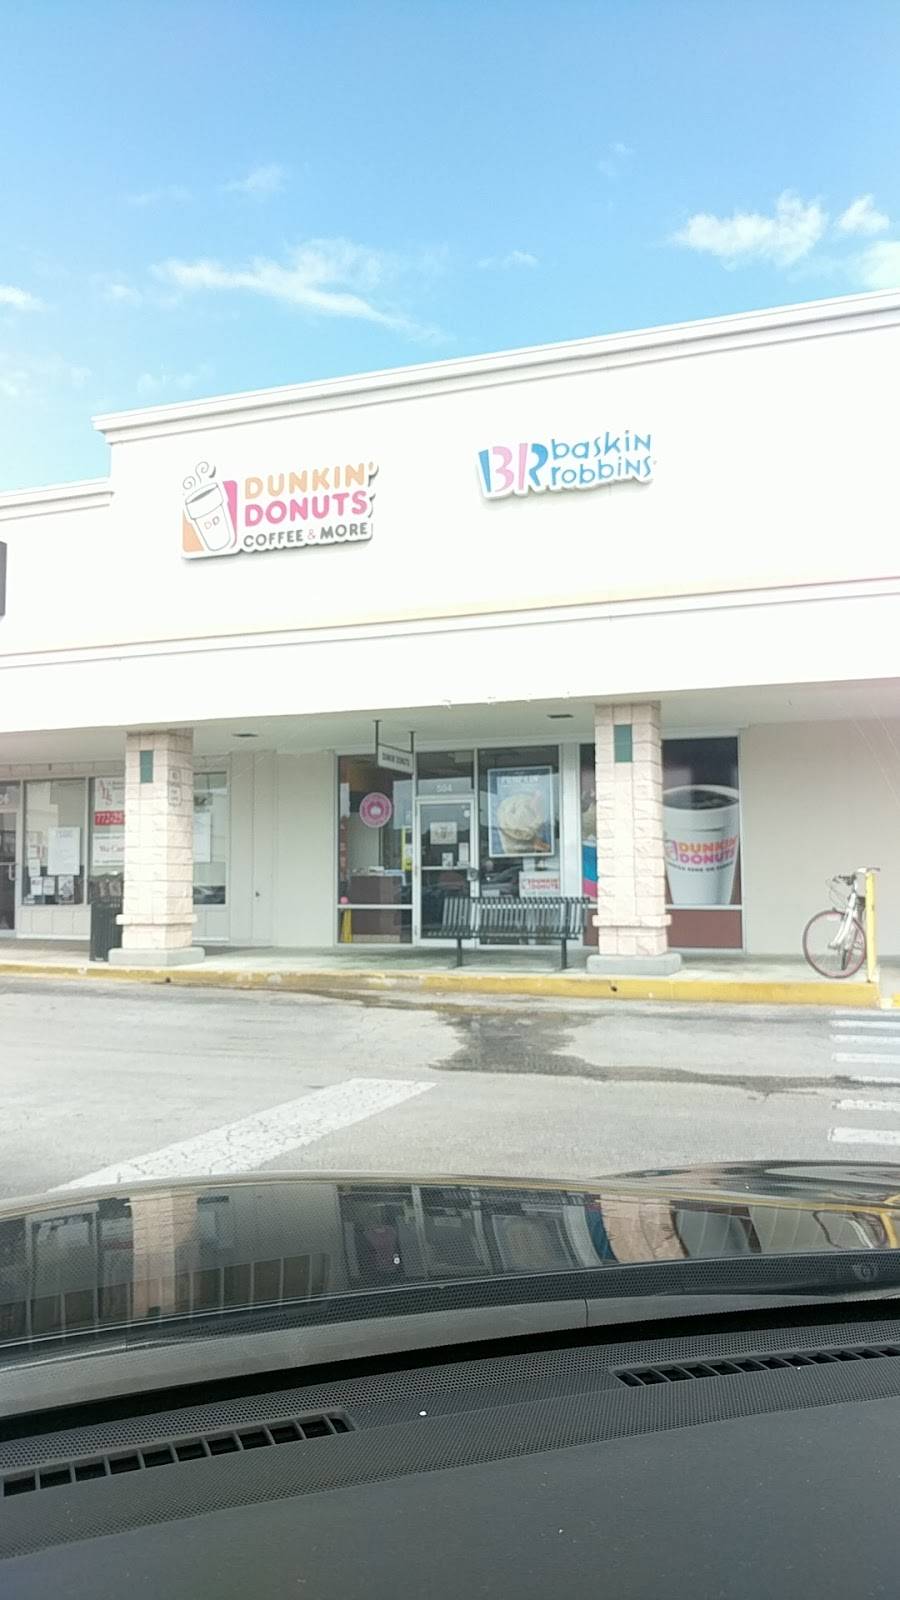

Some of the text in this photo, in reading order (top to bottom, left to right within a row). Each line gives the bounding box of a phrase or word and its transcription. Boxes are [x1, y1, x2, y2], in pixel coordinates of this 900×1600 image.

[551, 430, 652, 460] baskin
[244, 461, 374, 500] DUNKIN'
[551, 456, 652, 486] robbins
[244, 490, 368, 527] DONUTS
[243, 521, 368, 548] COFFEE & MORE
